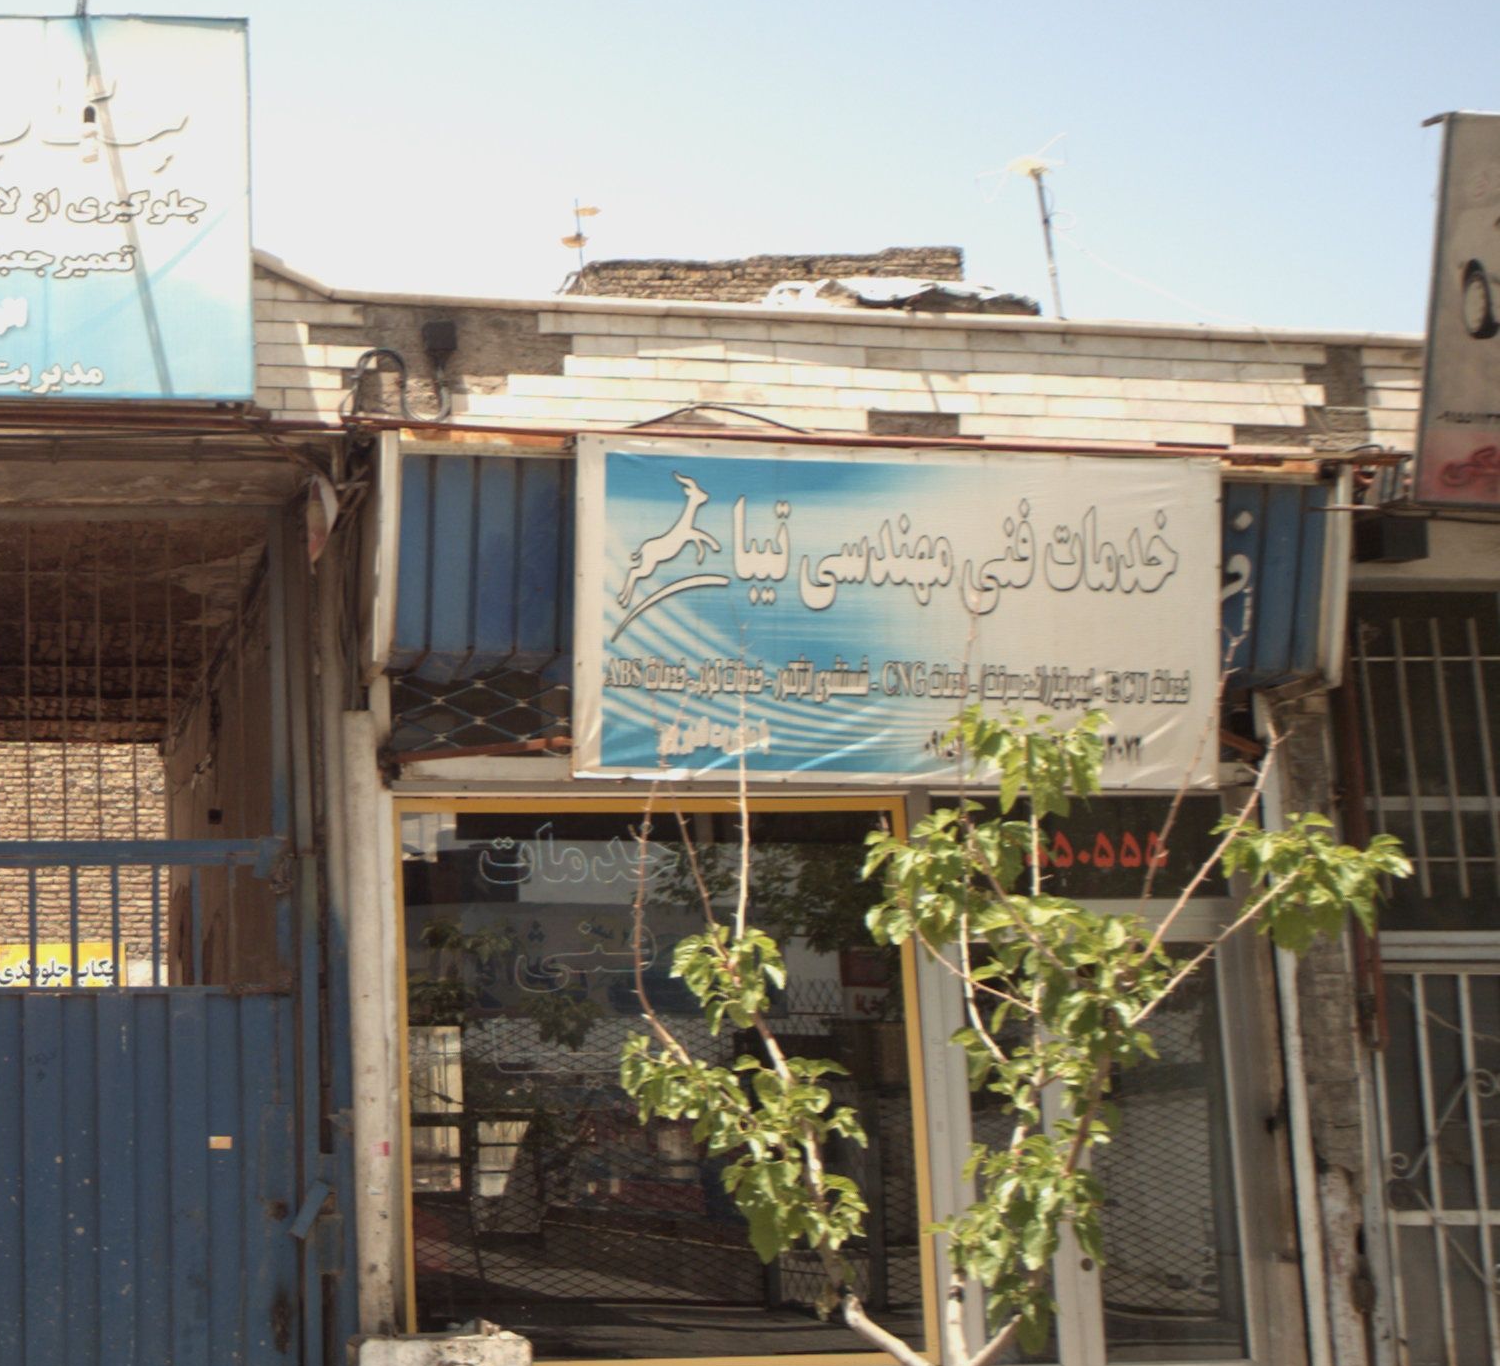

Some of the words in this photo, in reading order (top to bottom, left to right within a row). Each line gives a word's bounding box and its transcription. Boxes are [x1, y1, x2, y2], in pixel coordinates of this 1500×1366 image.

[27, 188, 60, 223] از
[65, 189, 207, 224] جلوگیری
[53, 245, 138, 279] تعمیر
[732, 494, 792, 606] تیبا
[799, 513, 955, 611] مهندسی
[961, 498, 1037, 616] فنی
[1044, 505, 1179, 594] خدمات
[606, 657, 644, 688] ABS
[881, 659, 927, 698] CNG
